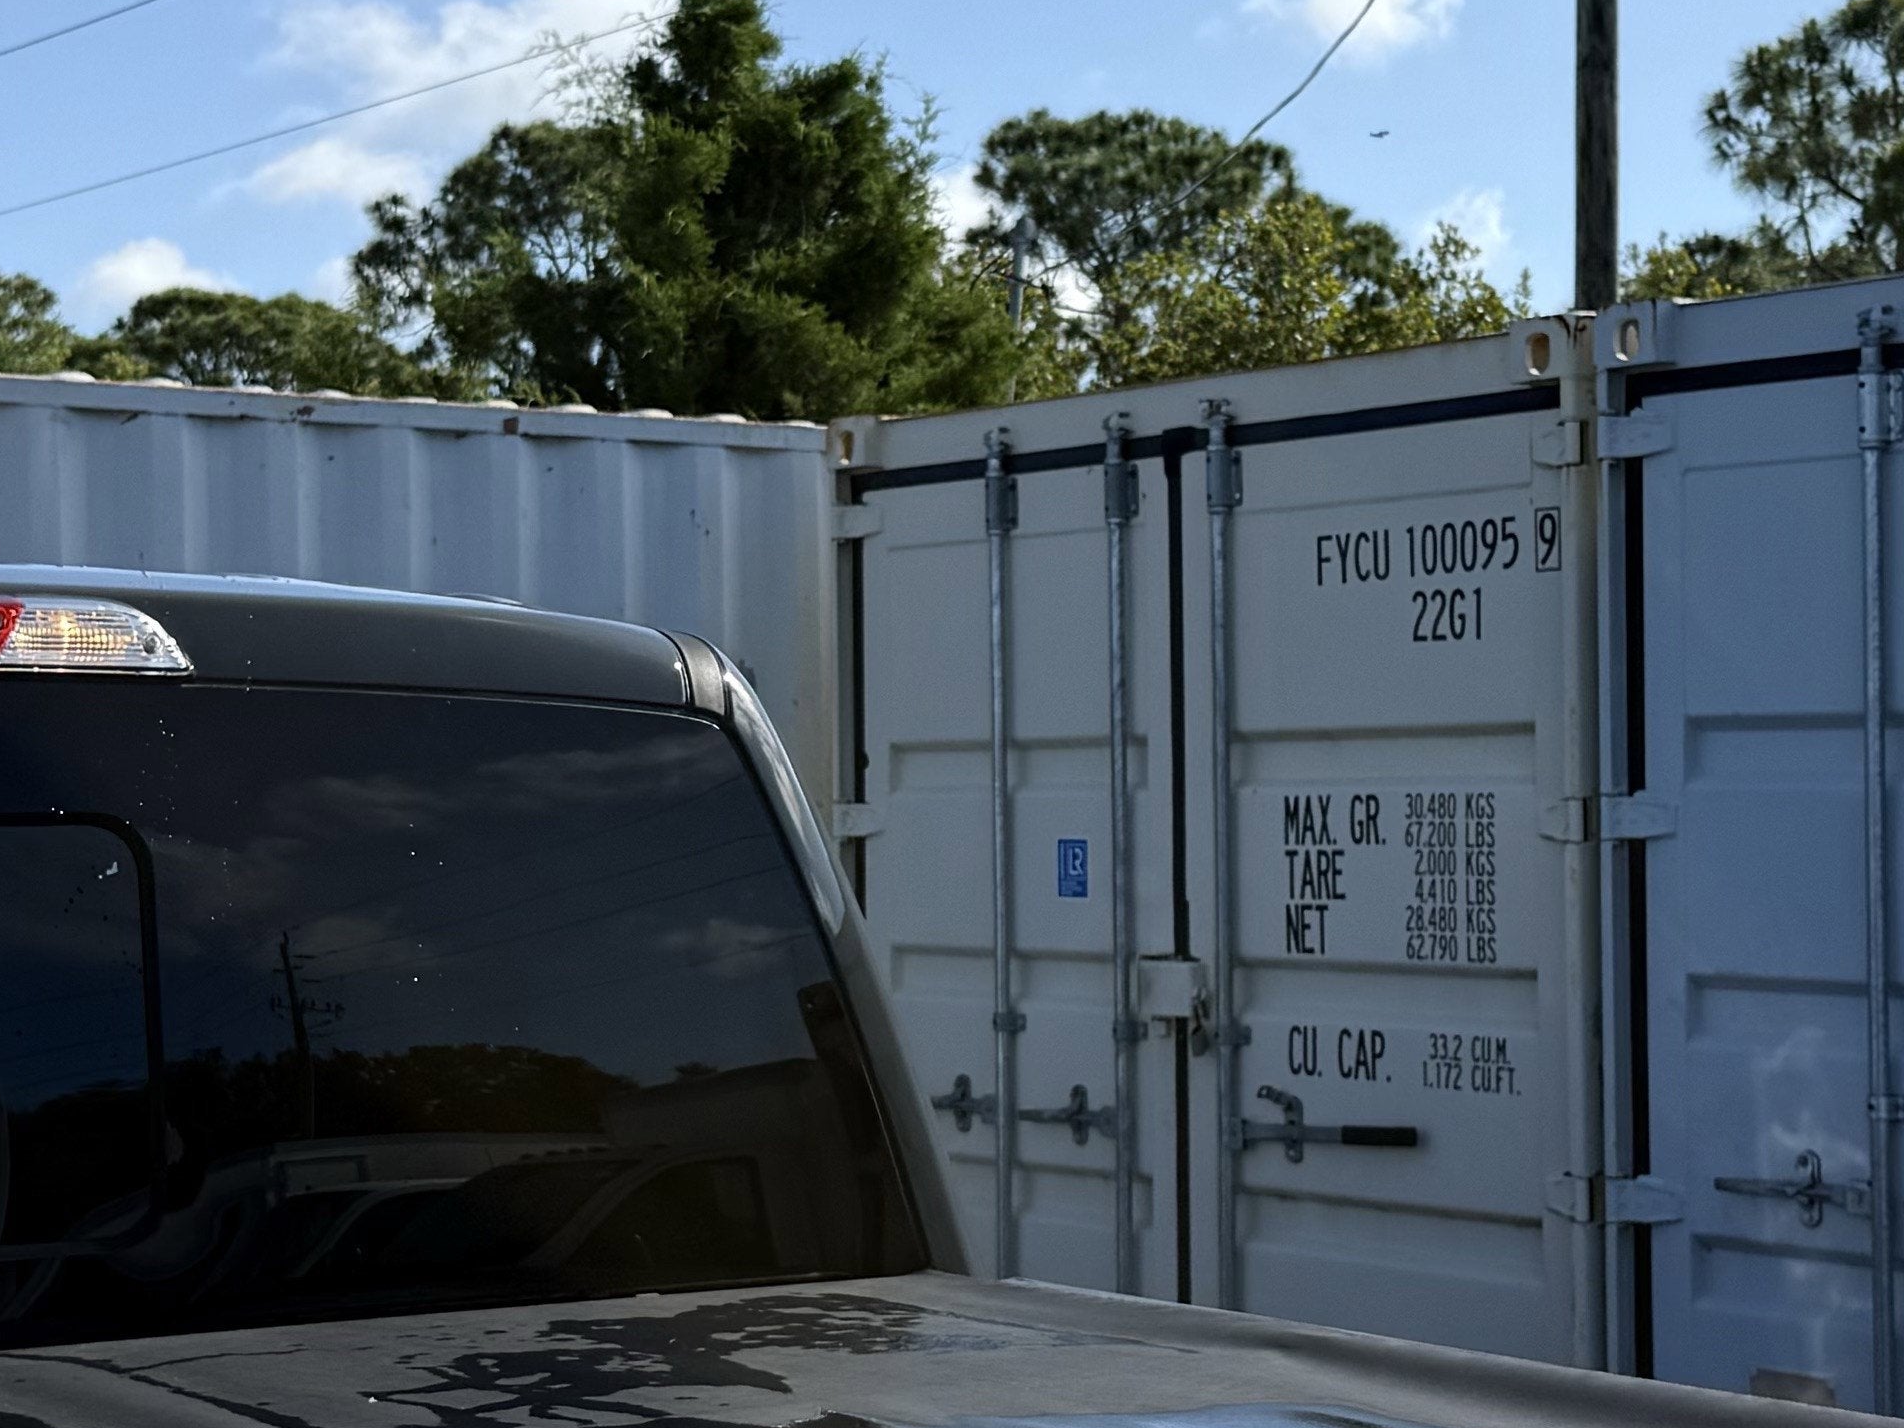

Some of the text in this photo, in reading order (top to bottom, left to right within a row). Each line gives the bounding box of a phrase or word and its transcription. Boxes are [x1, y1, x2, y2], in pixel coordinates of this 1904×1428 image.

[1316, 512, 1557, 587] FYCU 100095 9
[1411, 586, 1482, 643] 22G1
[1283, 791, 1496, 846] MAX. GR. 30.480 KGS
[1404, 820, 1496, 849] 67.200 LBS
[1284, 849, 1496, 901] TARE 2.000 KGS
[1414, 877, 1496, 907] 4.410 LBS
[1285, 903, 1497, 956] NET 28.480 KGS
[1405, 934, 1497, 965] 62.790 LBS
[1288, 1025, 1323, 1078] CU.
[1337, 1027, 1392, 1083] CAP.
[1429, 1032, 1463, 1063] 33.2
[1422, 1060, 1463, 1092] 1.172
